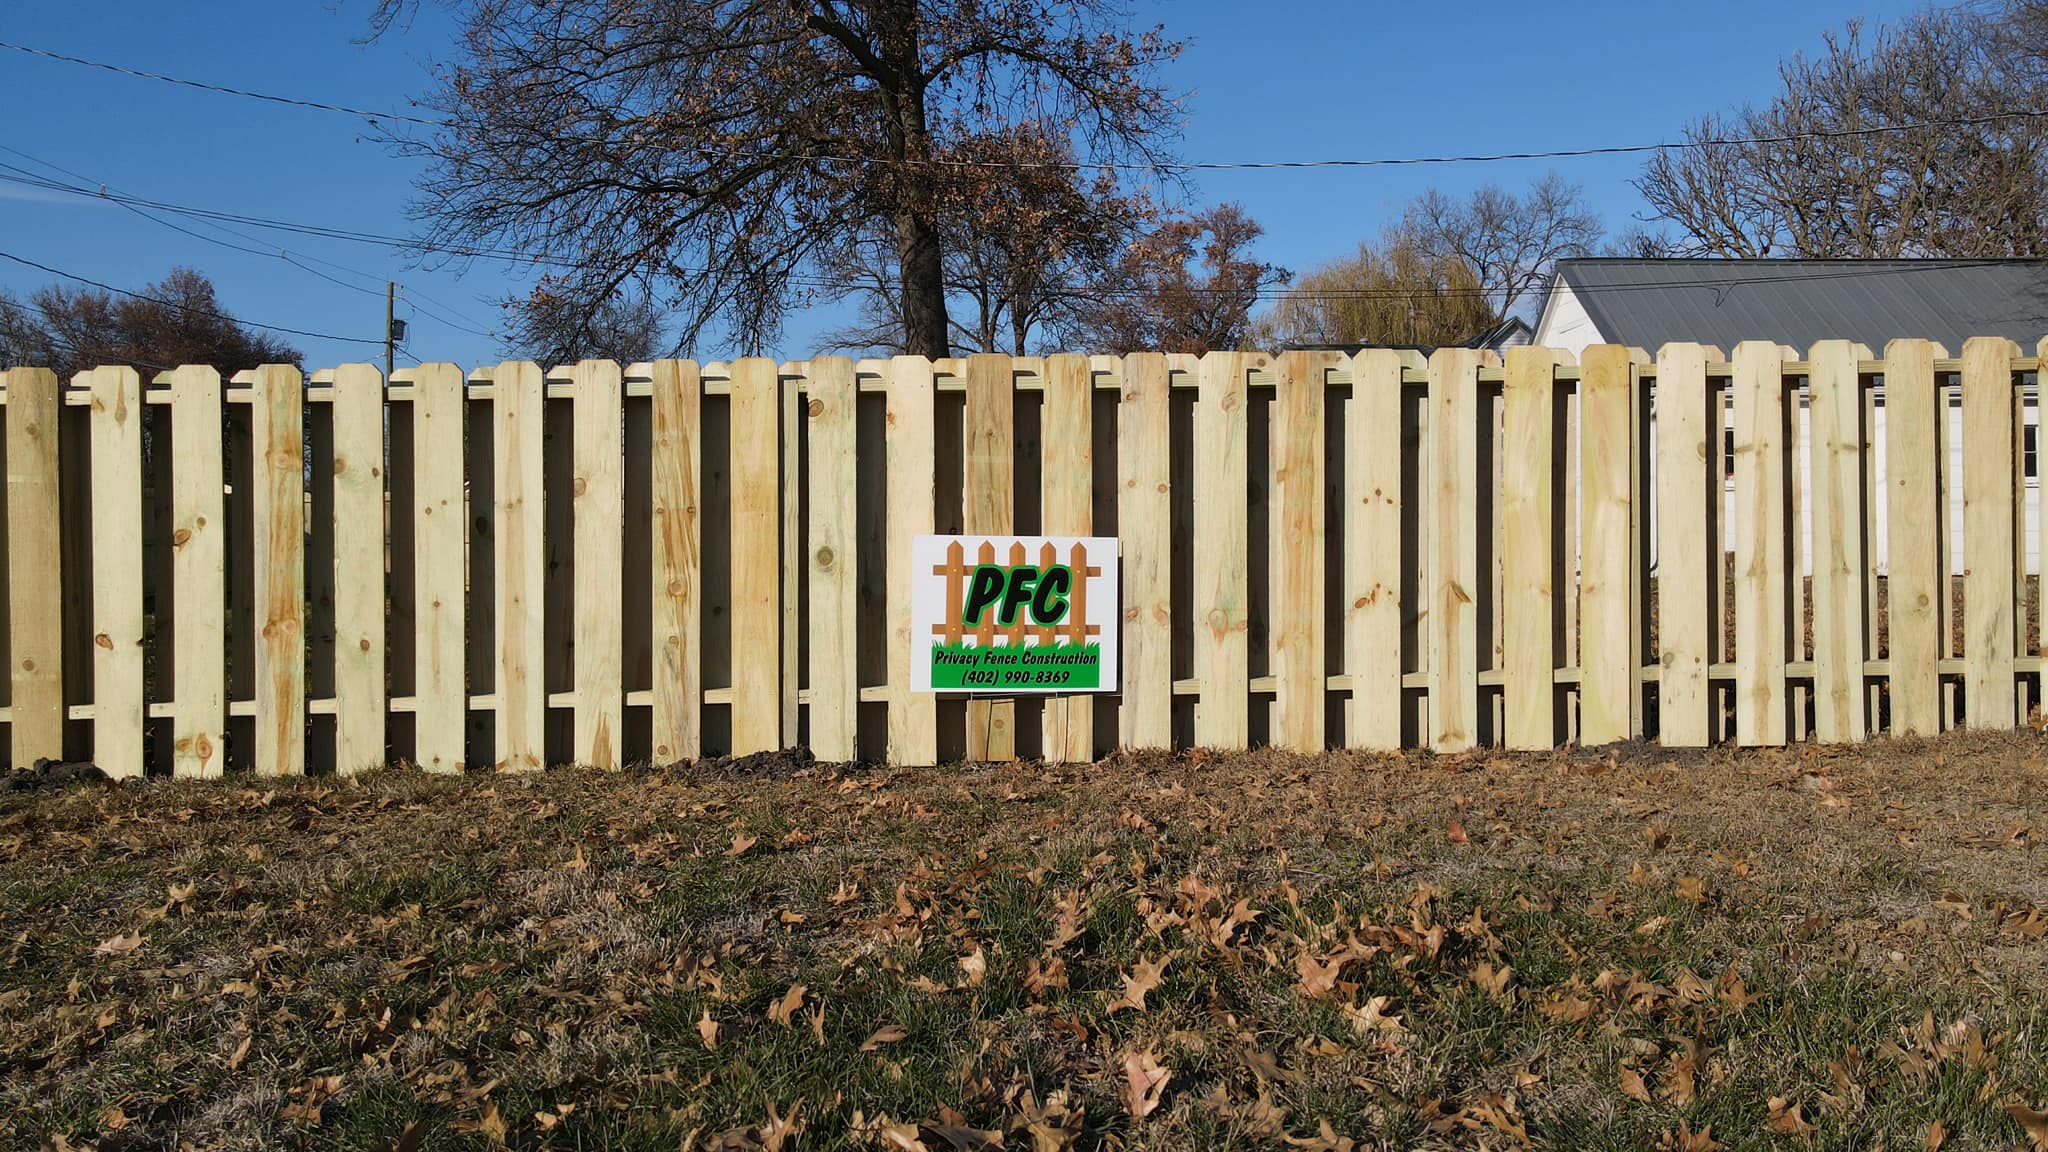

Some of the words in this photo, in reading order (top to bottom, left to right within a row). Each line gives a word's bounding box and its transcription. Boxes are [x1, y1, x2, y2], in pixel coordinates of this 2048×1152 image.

[964, 566, 1071, 625] PFC
[935, 650, 979, 667] Privacy
[984, 651, 1017, 665] Fence
[1022, 651, 1097, 665] Construction
[961, 670, 999, 685] (402)
[1005, 671, 1070, 684] 990-8369
